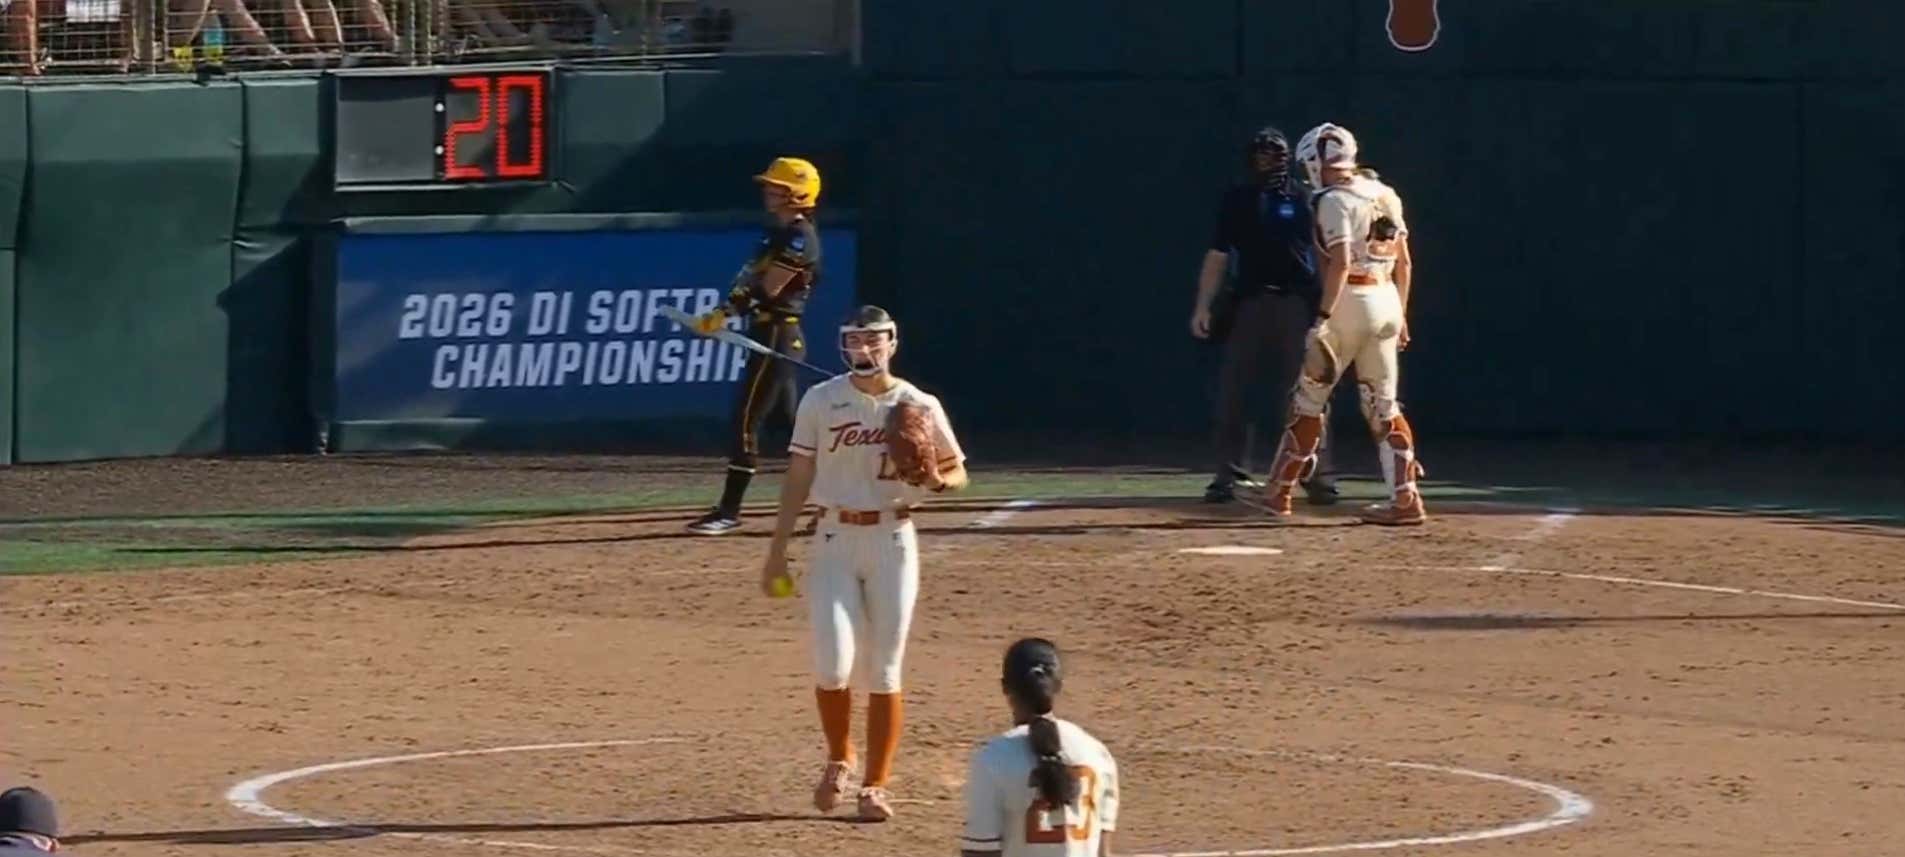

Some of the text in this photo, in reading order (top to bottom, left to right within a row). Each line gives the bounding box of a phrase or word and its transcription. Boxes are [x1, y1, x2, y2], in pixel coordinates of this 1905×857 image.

[445, 76, 542, 178] 20
[399, 292, 515, 338] 2026
[527, 291, 573, 335] DI
